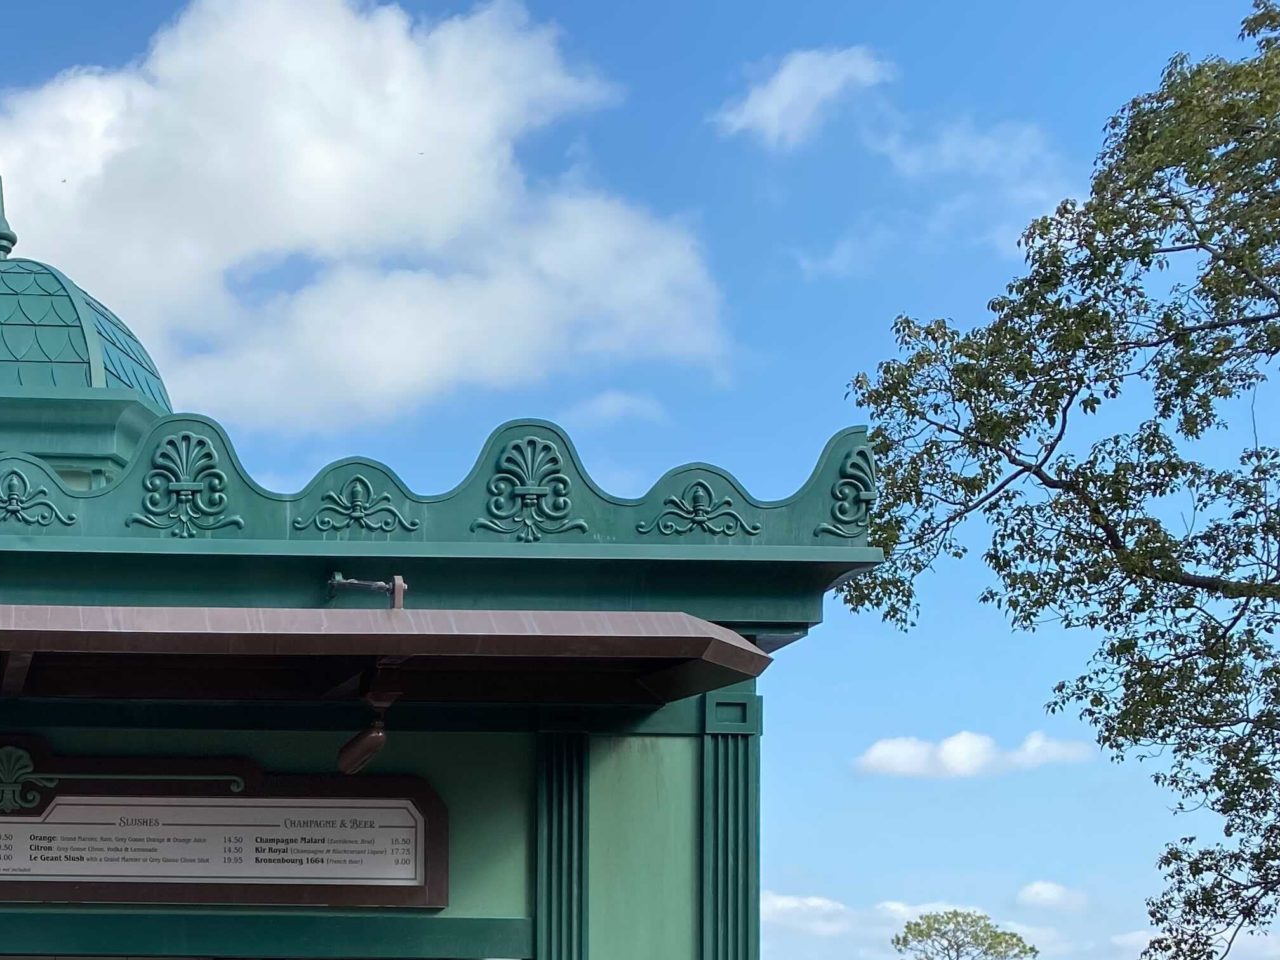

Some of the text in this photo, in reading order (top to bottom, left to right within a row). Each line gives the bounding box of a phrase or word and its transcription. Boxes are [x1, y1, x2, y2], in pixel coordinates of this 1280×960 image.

[118, 816, 160, 827] SLUSHES
[284, 818, 376, 829] CHAMPAGNE & BEER
[255, 836, 298, 845] Champagne
[268, 847, 289, 855] Royal
[255, 857, 304, 866] Kronenbourg
